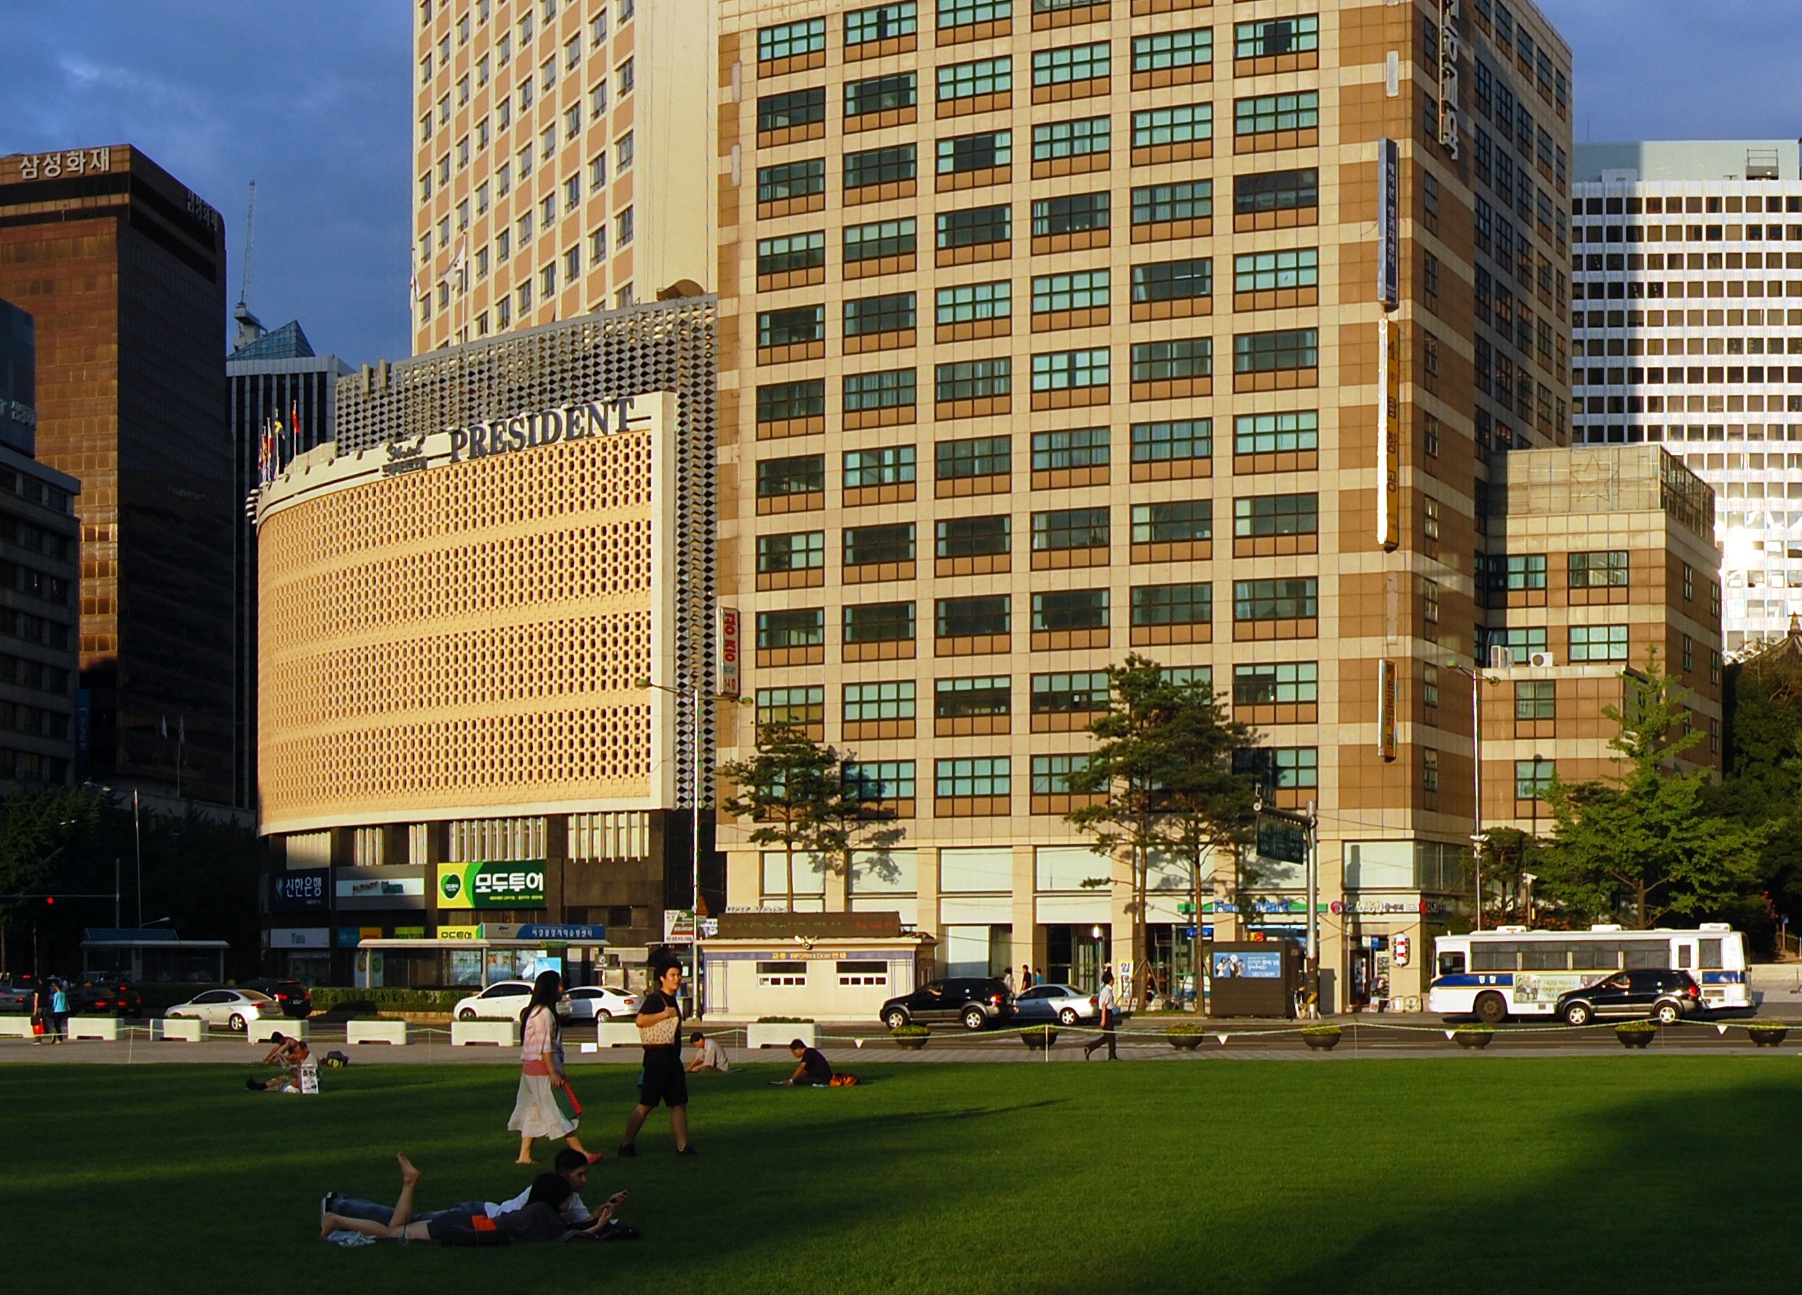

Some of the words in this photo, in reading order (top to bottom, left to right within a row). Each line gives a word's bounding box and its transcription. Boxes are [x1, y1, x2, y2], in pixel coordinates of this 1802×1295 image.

[19, 147, 111, 180] 삼성화재
[449, 396, 635, 464] PRESIDENT
[285, 876, 322, 898] 신한은행
[475, 872, 544, 893] 모두투어
